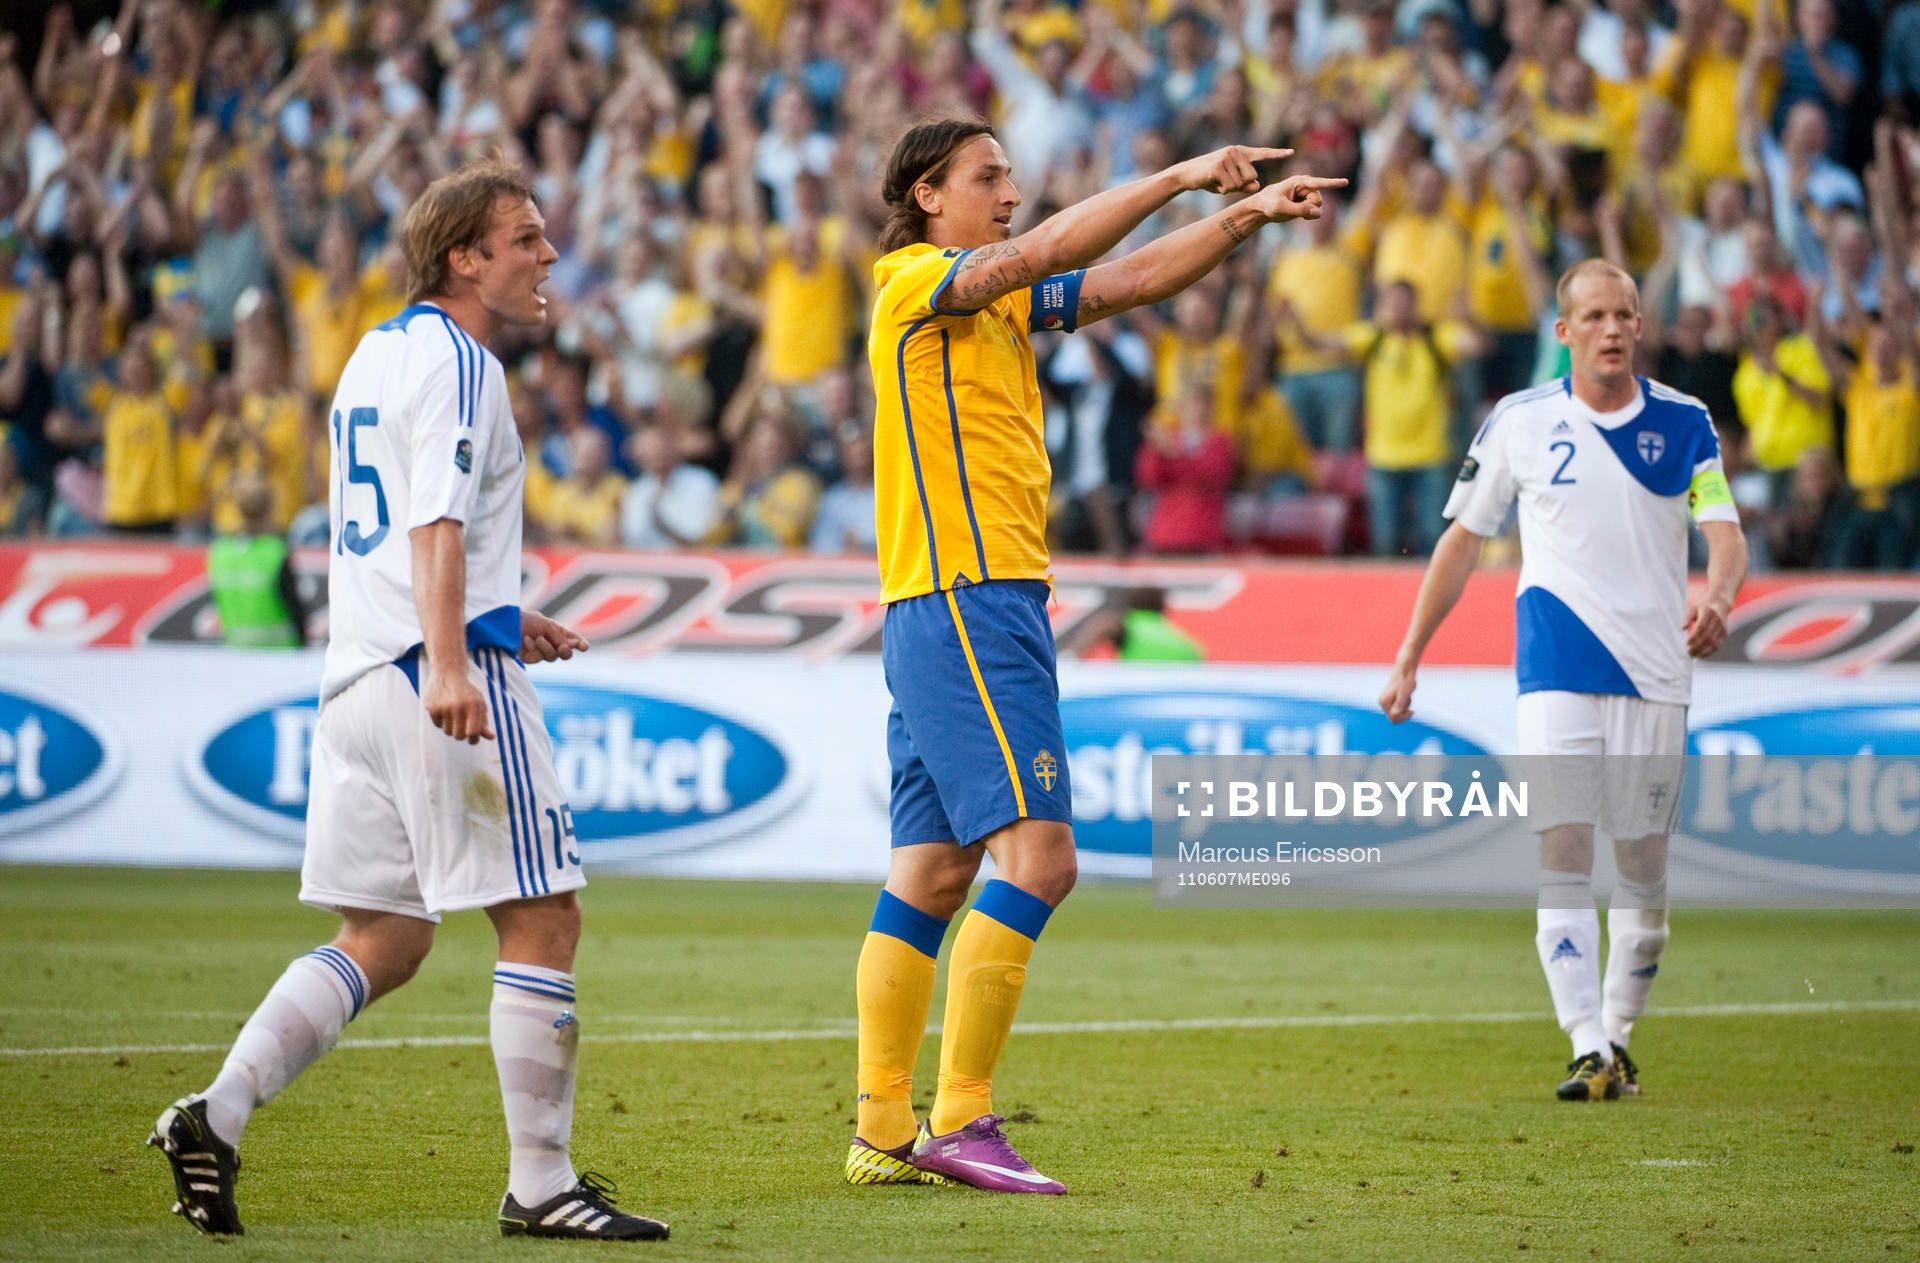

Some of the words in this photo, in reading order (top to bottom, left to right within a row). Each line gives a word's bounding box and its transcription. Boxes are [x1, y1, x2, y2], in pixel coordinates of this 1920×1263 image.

[1043, 283, 1051, 309] UNITE
[333, 407, 391, 557] 15
[1550, 441, 1577, 485] 2
